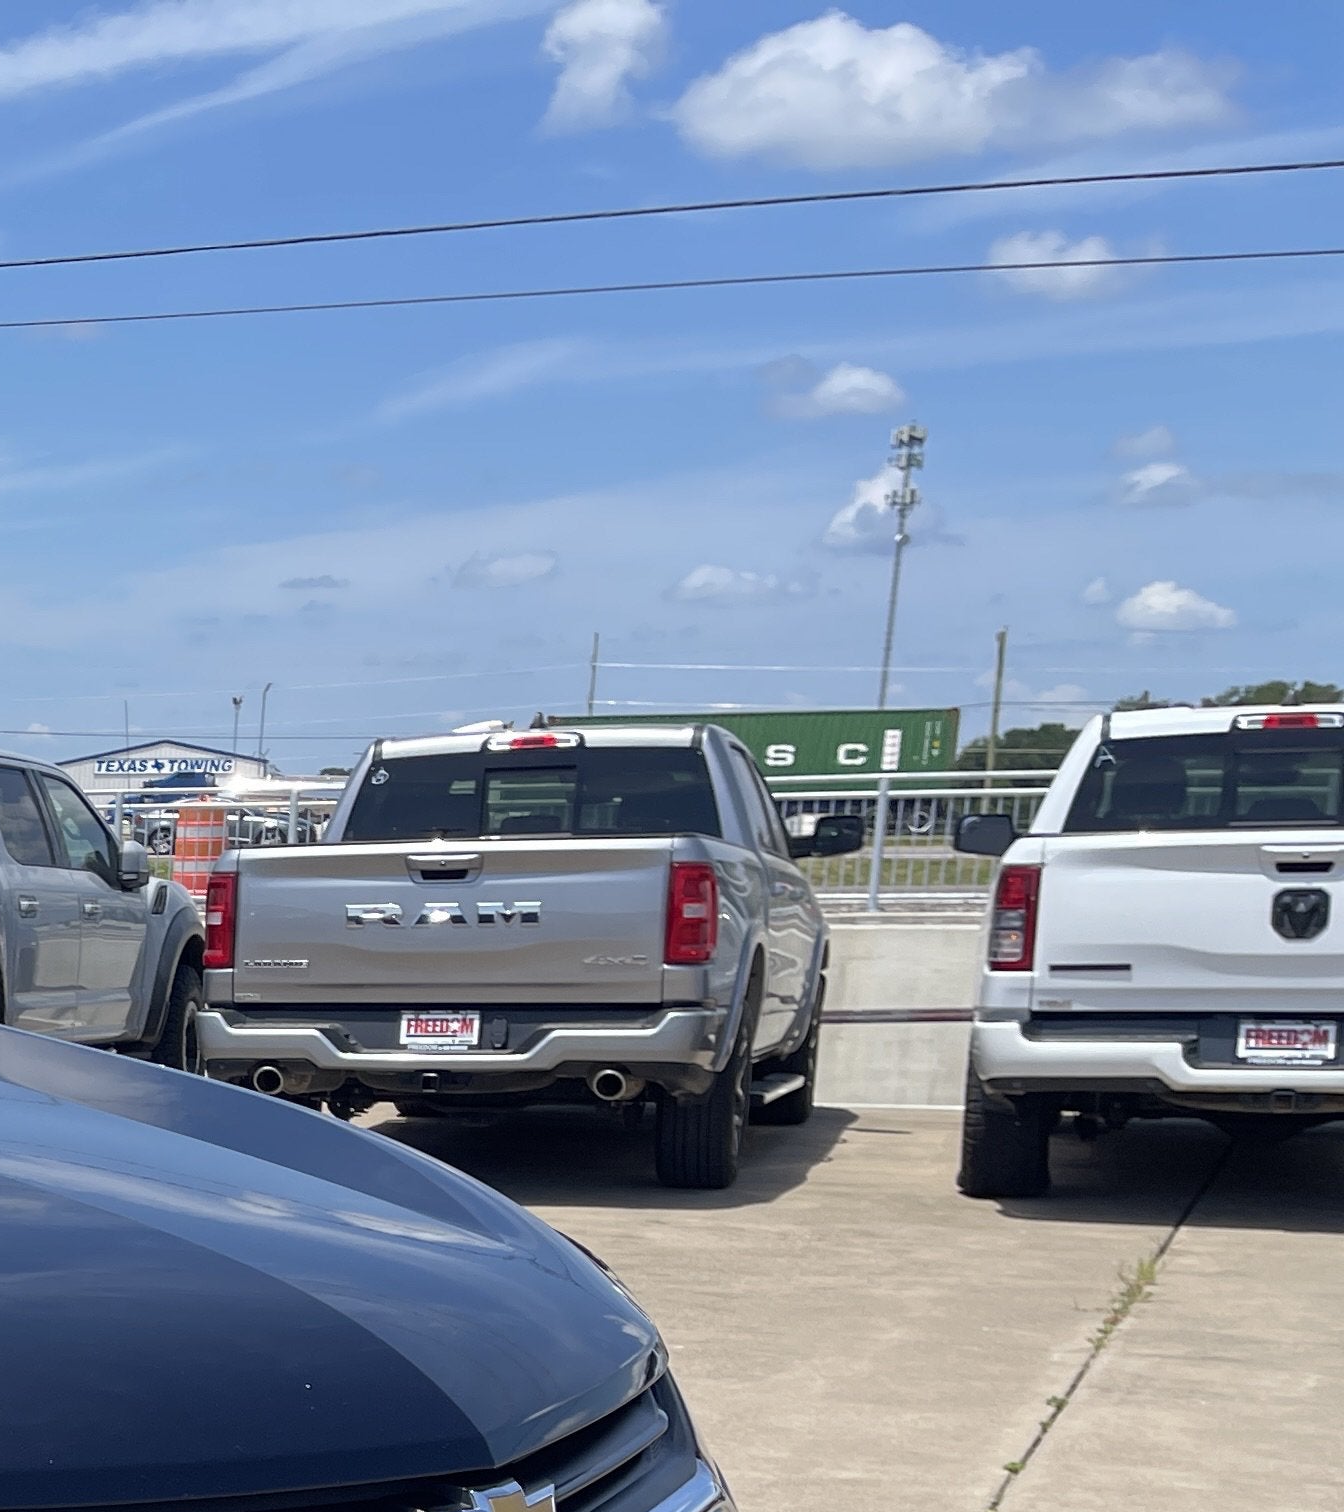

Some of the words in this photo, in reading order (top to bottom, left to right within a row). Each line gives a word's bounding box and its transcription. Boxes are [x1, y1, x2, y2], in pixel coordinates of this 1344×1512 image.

[96, 760, 148, 772] TEXAS
[168, 760, 233, 772] TOWING
[345, 902, 543, 928] RAM
[406, 1018, 475, 1034] FREEDOM
[1245, 1028, 1330, 1046] FREEDOM
